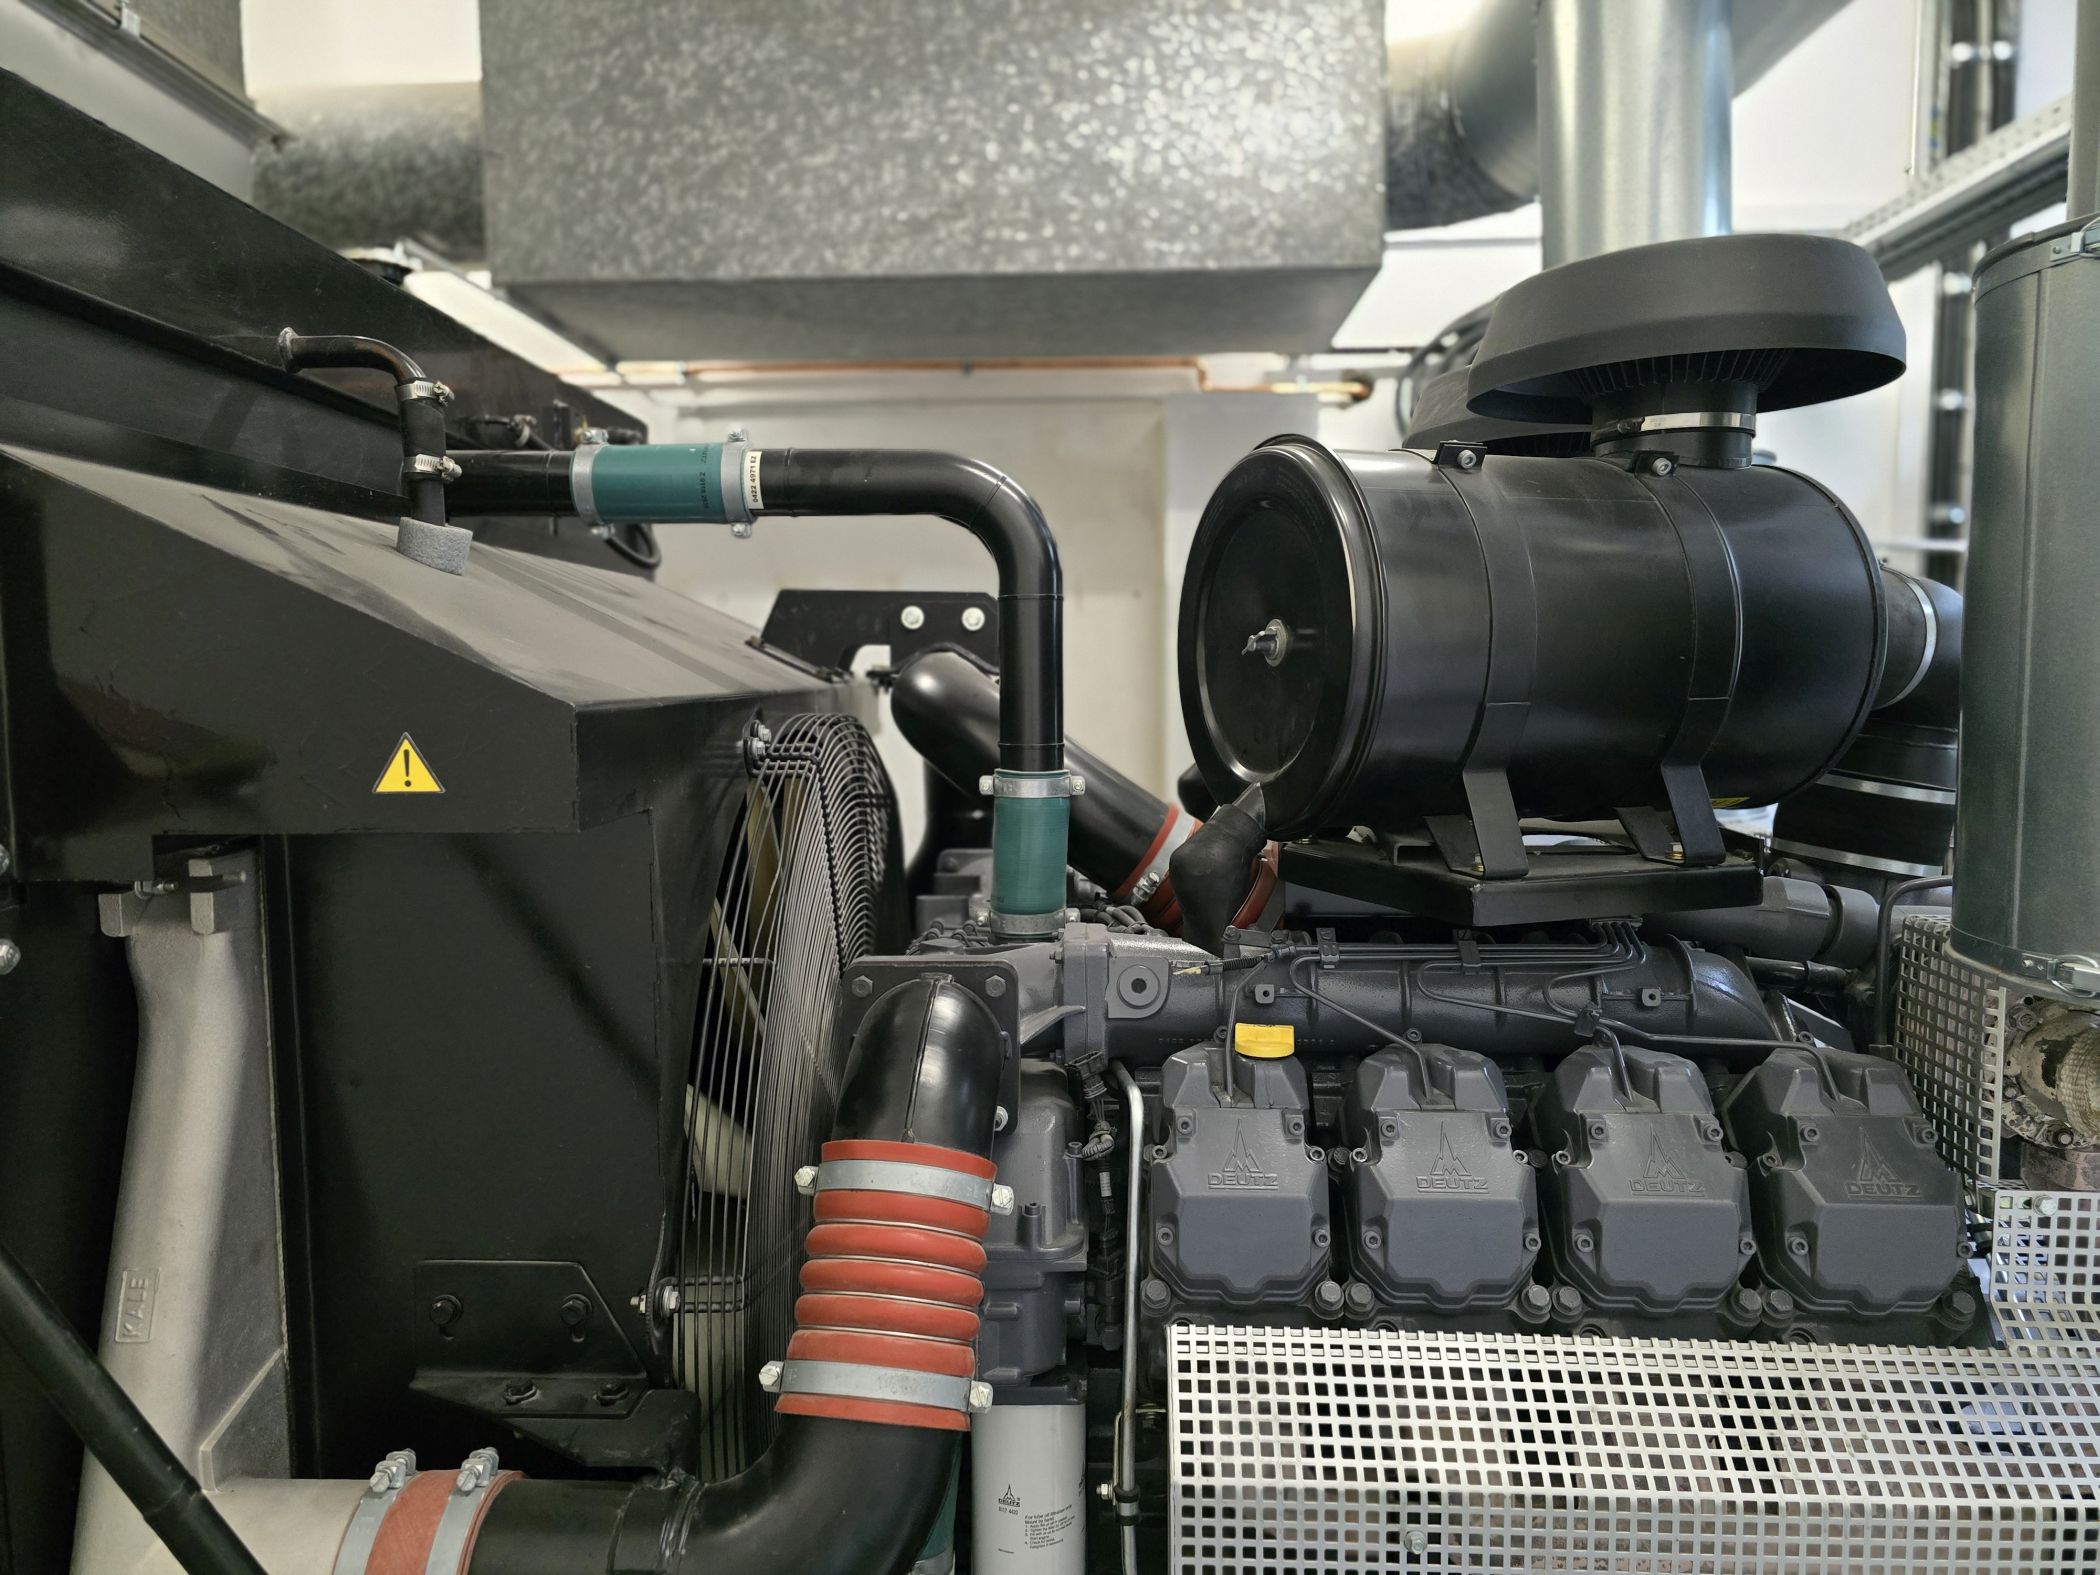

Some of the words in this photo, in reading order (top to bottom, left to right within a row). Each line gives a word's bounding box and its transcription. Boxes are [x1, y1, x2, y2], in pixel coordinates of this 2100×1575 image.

[750, 485, 759, 503] 0422
[1208, 1172, 1279, 1187] DEUTZ
[1416, 1175, 1489, 1191] DEUTZ
[1627, 1179, 1705, 1194] DEUTZ
[1843, 1181, 1921, 1197] DEUTZ
[121, 1278, 149, 1338] KALE
